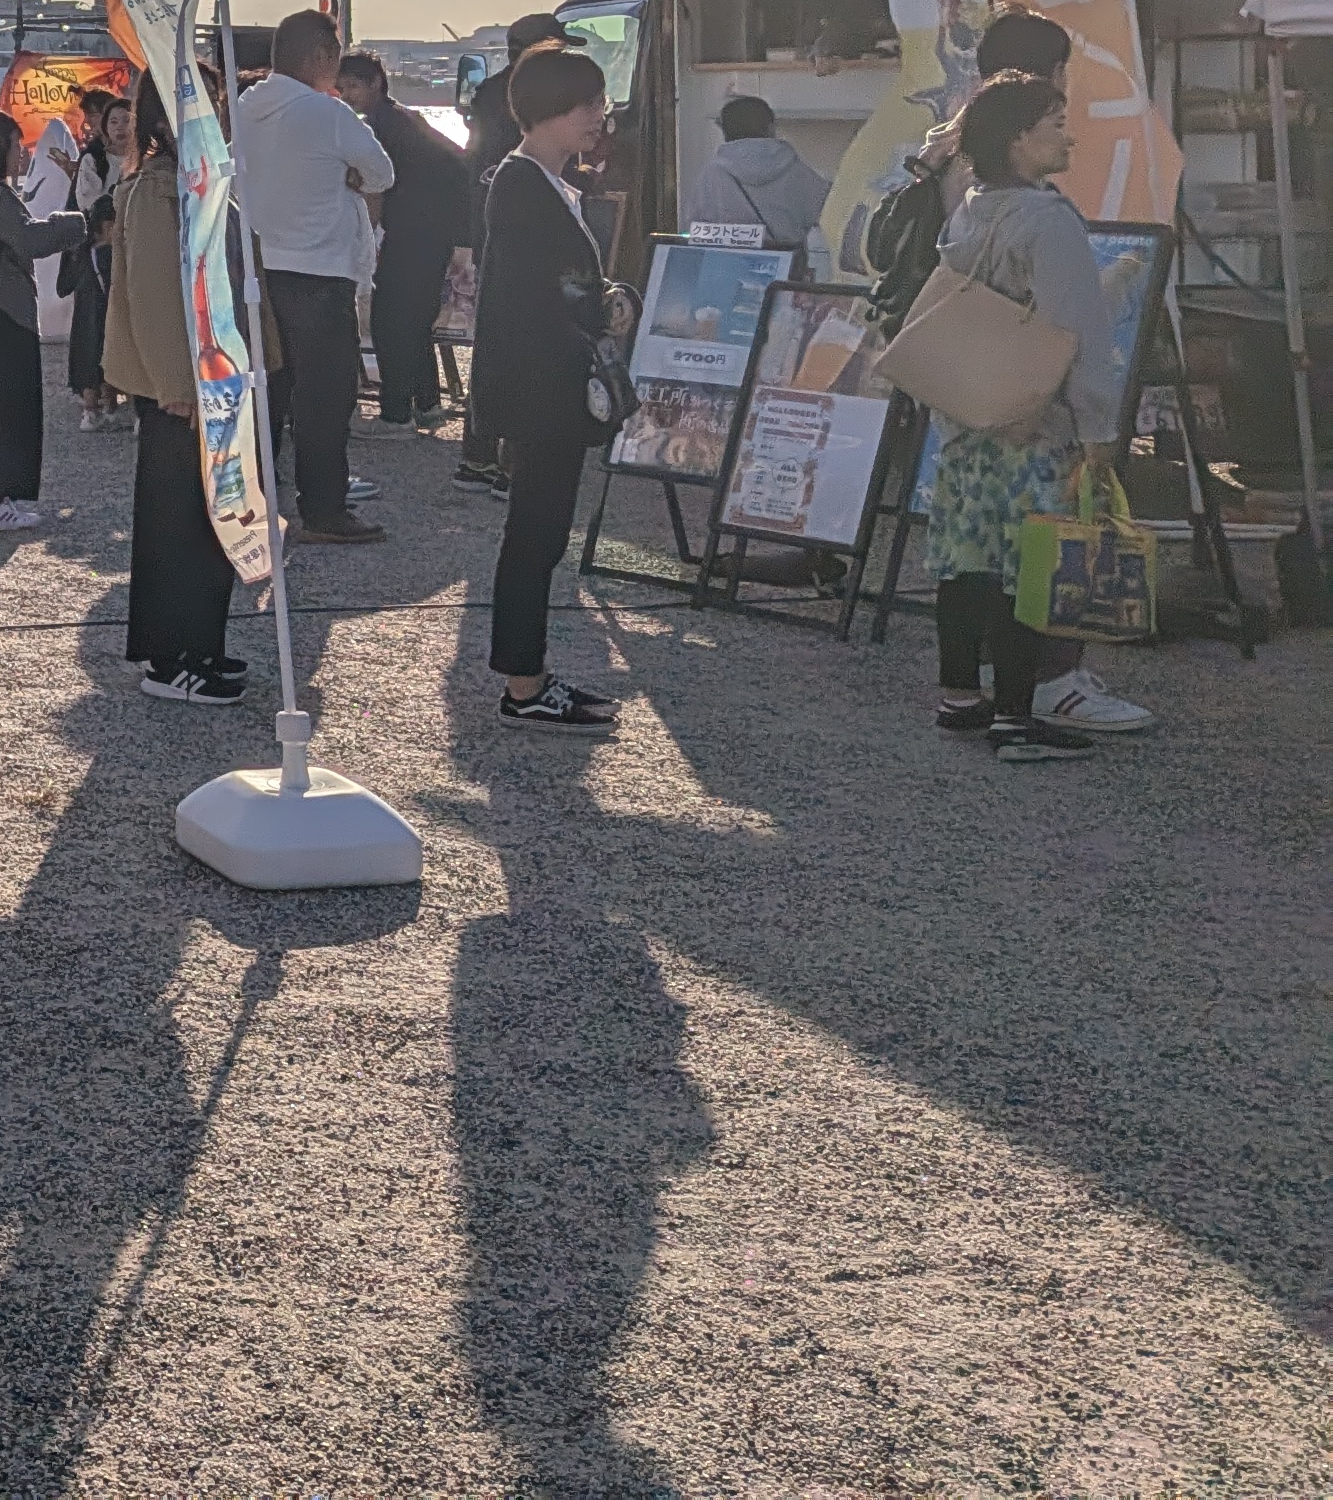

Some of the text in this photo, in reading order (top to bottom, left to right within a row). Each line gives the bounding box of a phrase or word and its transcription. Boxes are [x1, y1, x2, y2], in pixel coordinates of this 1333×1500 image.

[692, 224, 761, 239] クラフトビール
[692, 236, 723, 245] Craft
